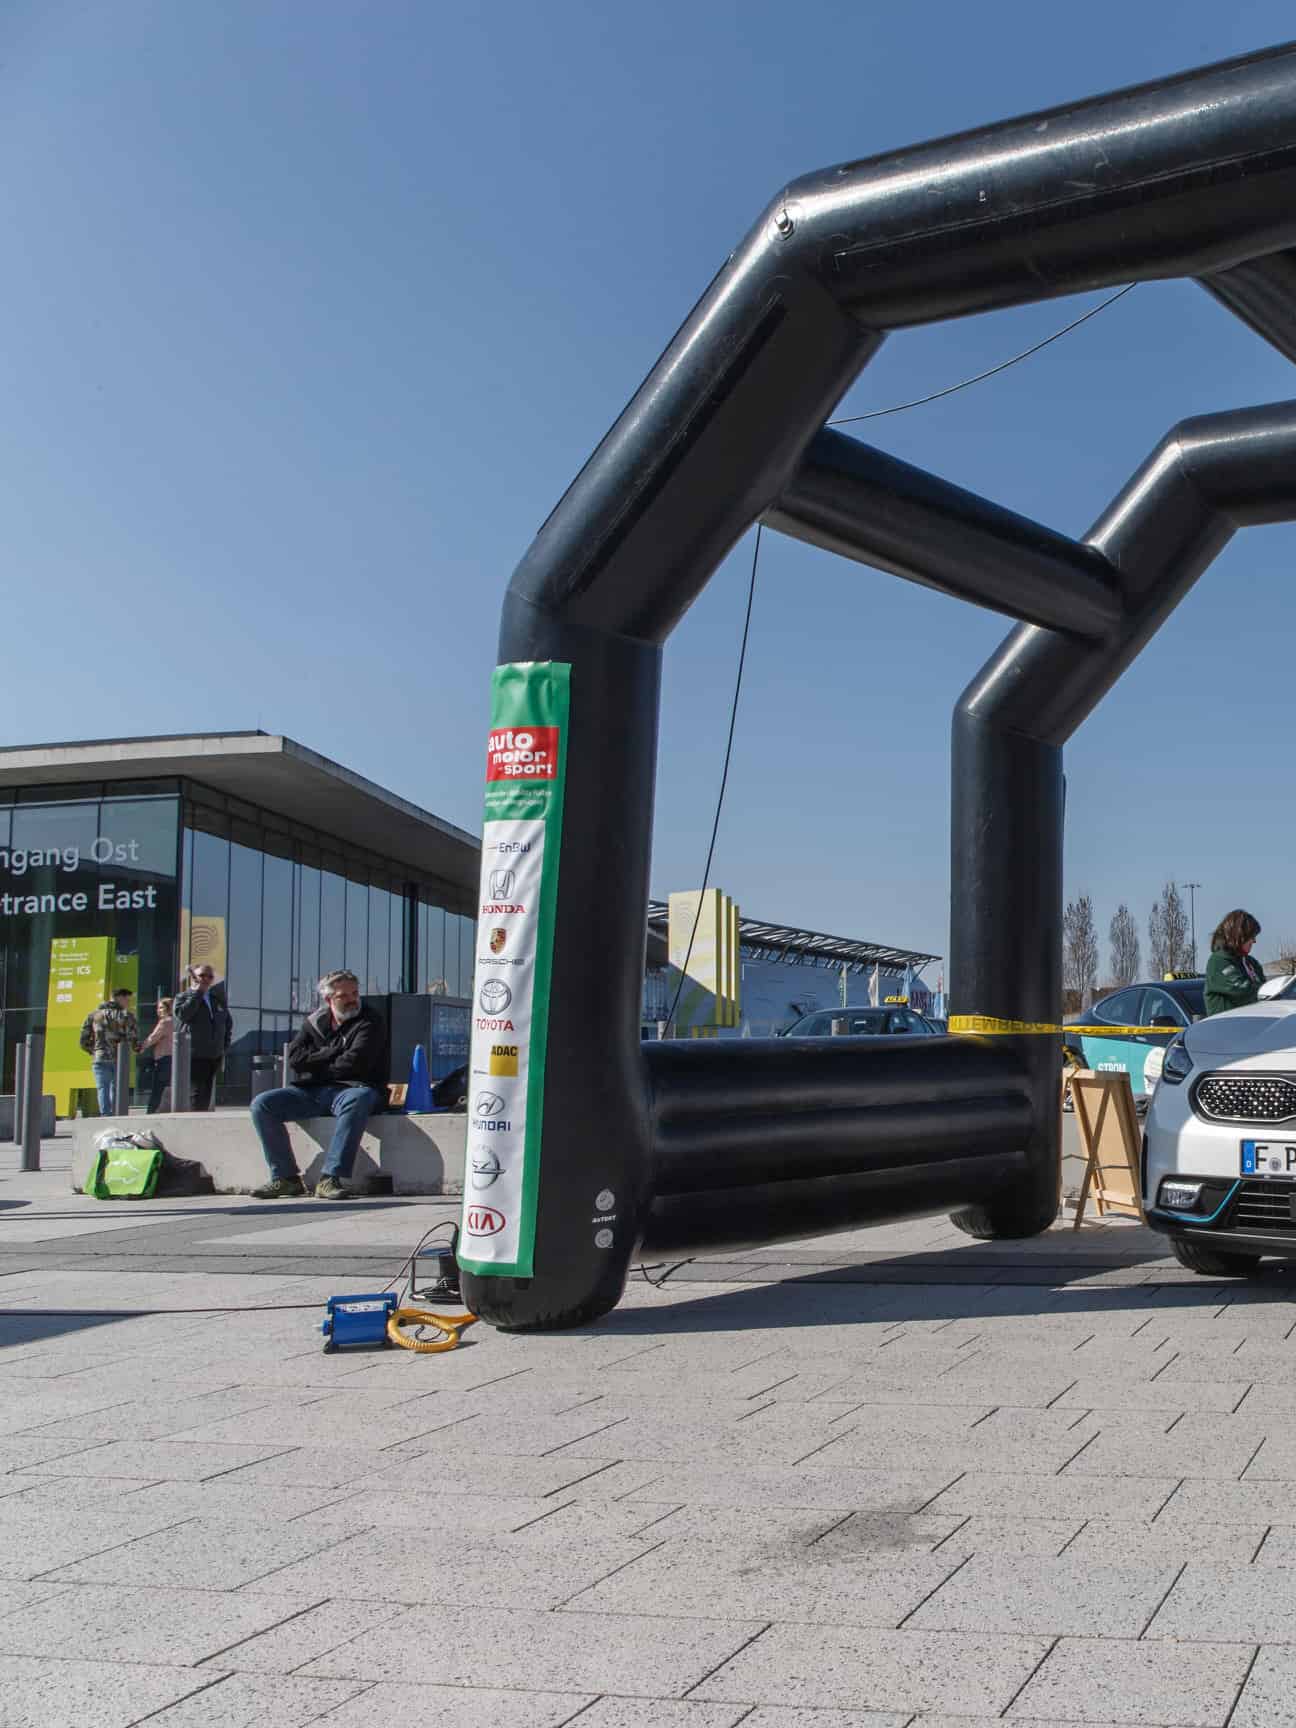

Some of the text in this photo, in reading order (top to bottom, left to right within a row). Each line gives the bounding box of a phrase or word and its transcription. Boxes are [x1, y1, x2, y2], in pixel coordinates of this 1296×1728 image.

[488, 731, 534, 752] auto
[493, 750, 547, 765] motor
[504, 764, 552, 776] sport
[91, 837, 140, 864] Ost
[498, 841, 531, 854] EnBW
[98, 884, 157, 910] East
[482, 904, 525, 914] HONDA
[476, 1018, 514, 1031] TOYOTA
[491, 1046, 518, 1057] ADAC
[1255, 1146, 1269, 1170] F
